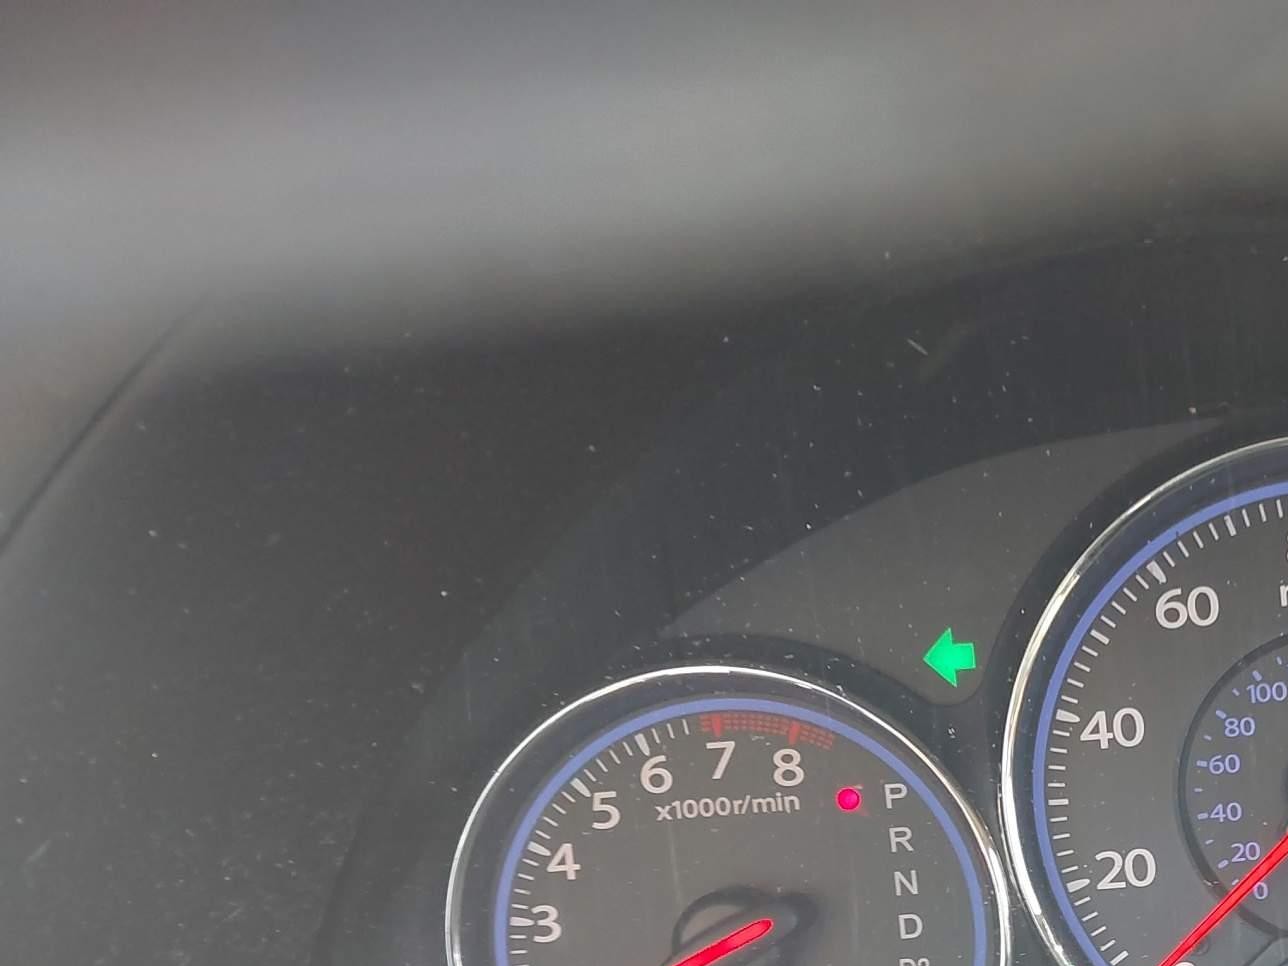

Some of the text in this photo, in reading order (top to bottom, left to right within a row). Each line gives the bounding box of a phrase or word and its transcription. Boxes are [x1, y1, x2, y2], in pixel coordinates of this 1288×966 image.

[1155, 585, 1220, 630] 60
[1247, 681, 1288, 703] 100
[1080, 707, 1145, 750] 40
[1224, 716, 1256, 738] 80
[640, 755, 673, 793] 6
[706, 742, 735, 779] 7
[772, 749, 804, 786] 8
[1209, 753, 1240, 775] 60
[655, 793, 801, 822] x1000r/min
[884, 783, 908, 809] P
[591, 791, 620, 830] 5
[1210, 801, 1242, 821] 40
[888, 827, 914, 853] R
[1230, 842, 1261, 863] 20
[546, 843, 581, 880] 4
[1095, 849, 1157, 889] 20
[893, 870, 919, 896] N
[1254, 882, 1269, 900] 0
[531, 904, 562, 942] 3
[899, 914, 923, 939] D
